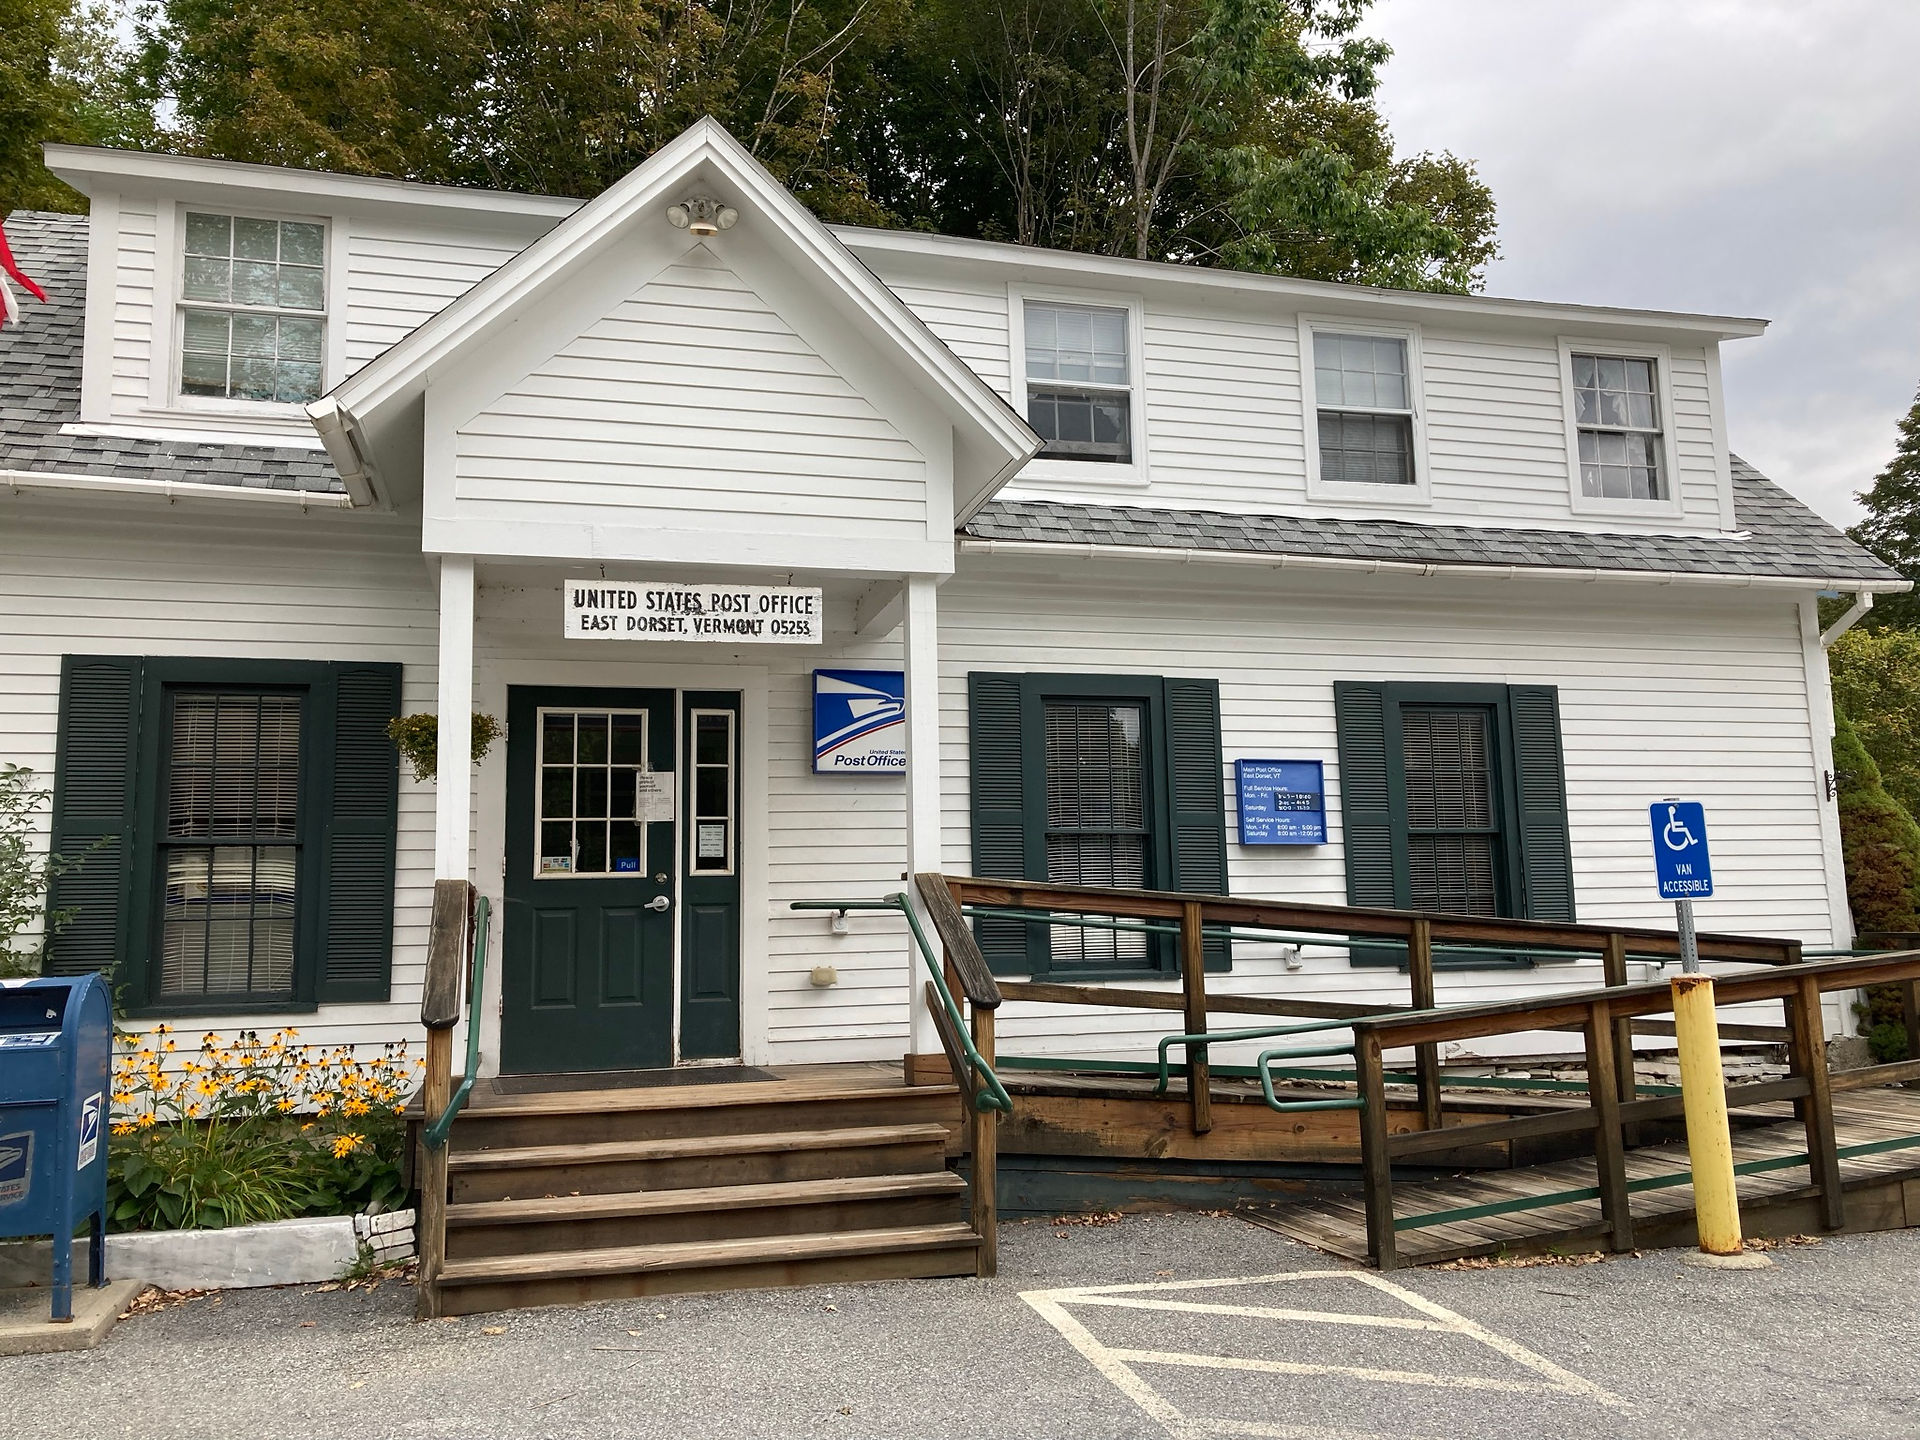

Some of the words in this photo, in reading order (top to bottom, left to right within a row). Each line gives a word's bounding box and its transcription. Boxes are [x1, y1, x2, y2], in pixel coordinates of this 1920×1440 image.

[574, 589, 637, 609] UNITED
[646, 590, 702, 612] STATES
[712, 594, 750, 612] POST
[760, 594, 812, 614] OFFICE
[582, 615, 618, 630] EAST
[627, 616, 688, 634] DORSET,
[694, 618, 764, 634] VERMONT
[771, 620, 810, 634] 05253
[834, 754, 866, 766] Post
[867, 755, 906, 766] Office
[1676, 864, 1692, 875] VAN
[1664, 880, 1709, 892] ACCESSIBLE
